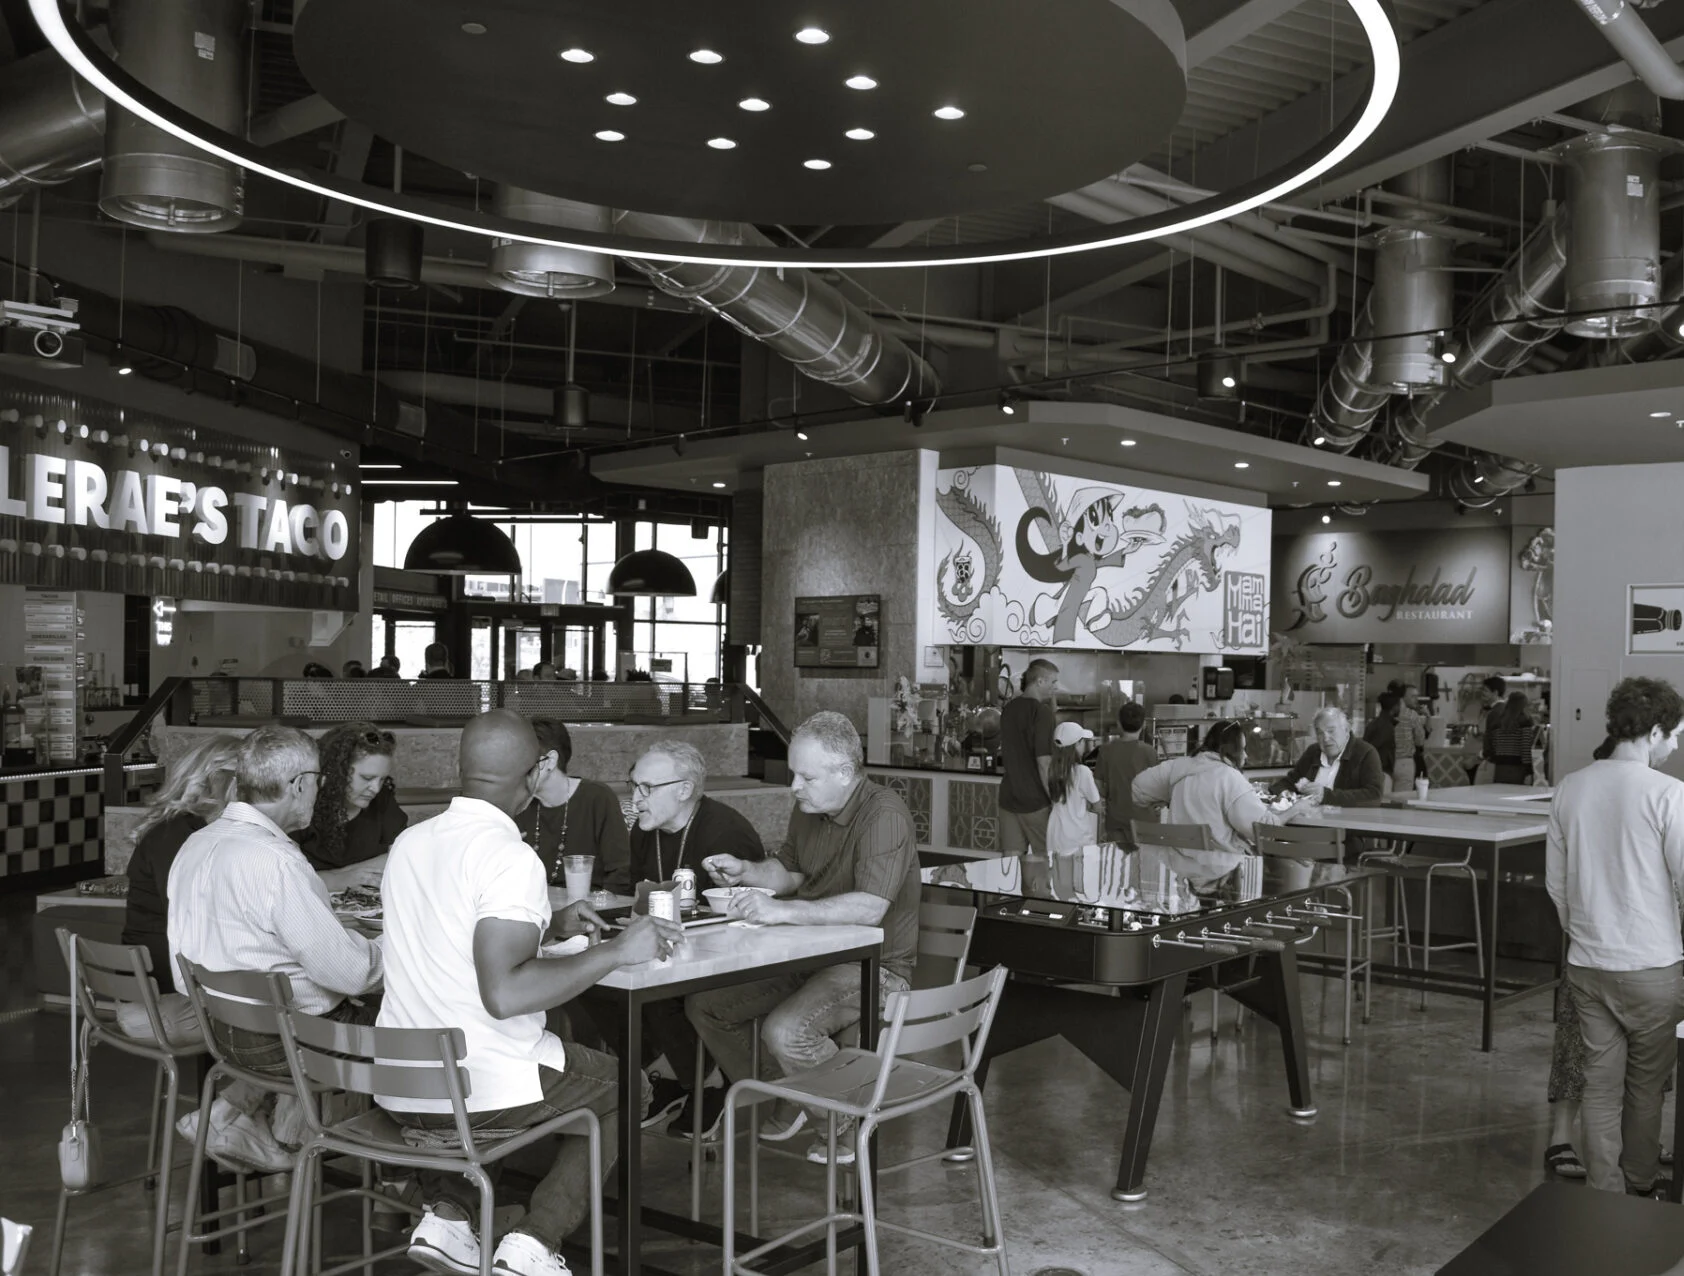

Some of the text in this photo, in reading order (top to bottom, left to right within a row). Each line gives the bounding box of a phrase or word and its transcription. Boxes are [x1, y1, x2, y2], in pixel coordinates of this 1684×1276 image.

[234, 491, 349, 560] TACO
[1336, 564, 1478, 622] Baghdad
[1396, 610, 1473, 620] RESTAURANT
[1228, 611, 1262, 644] Hai
